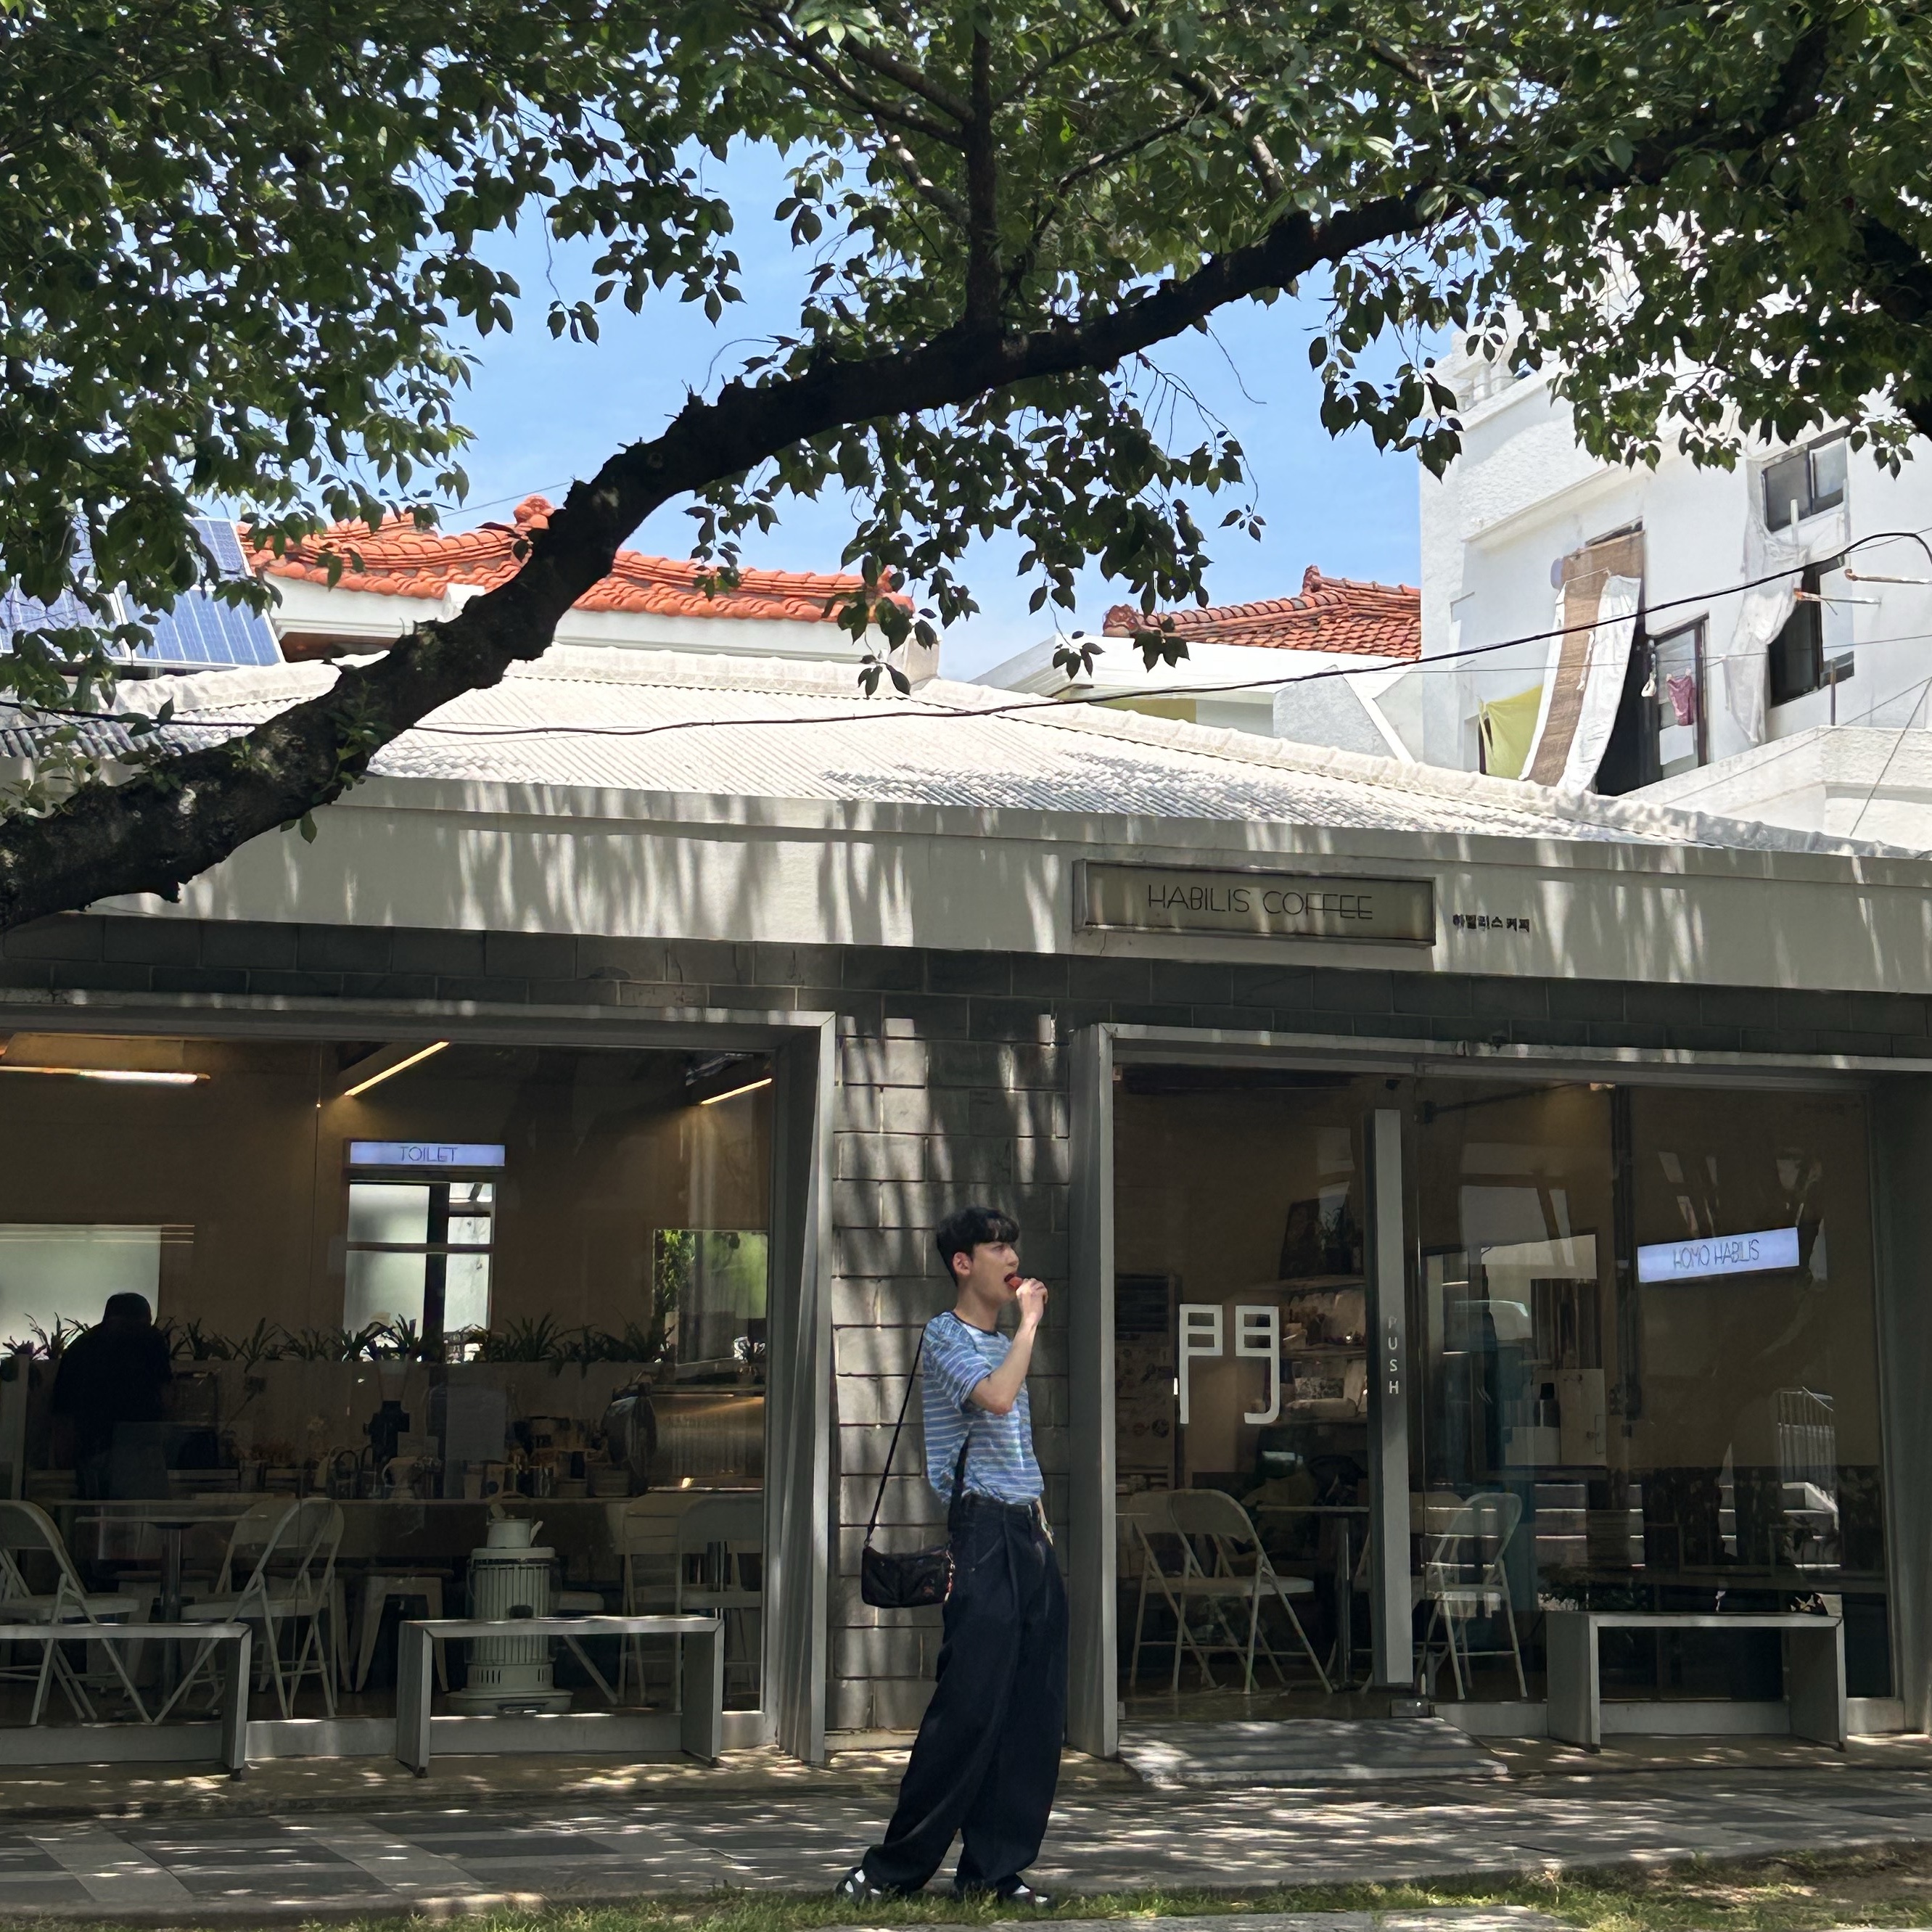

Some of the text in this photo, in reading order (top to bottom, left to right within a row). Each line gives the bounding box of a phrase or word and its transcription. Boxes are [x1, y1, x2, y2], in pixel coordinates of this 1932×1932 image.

[1148, 884, 1373, 919] HABILIS COFFEE
[400, 1146, 459, 1162] TOILET
[1673, 1244, 1710, 1270] HOMO
[1388, 1316, 1399, 1394] PUSH
